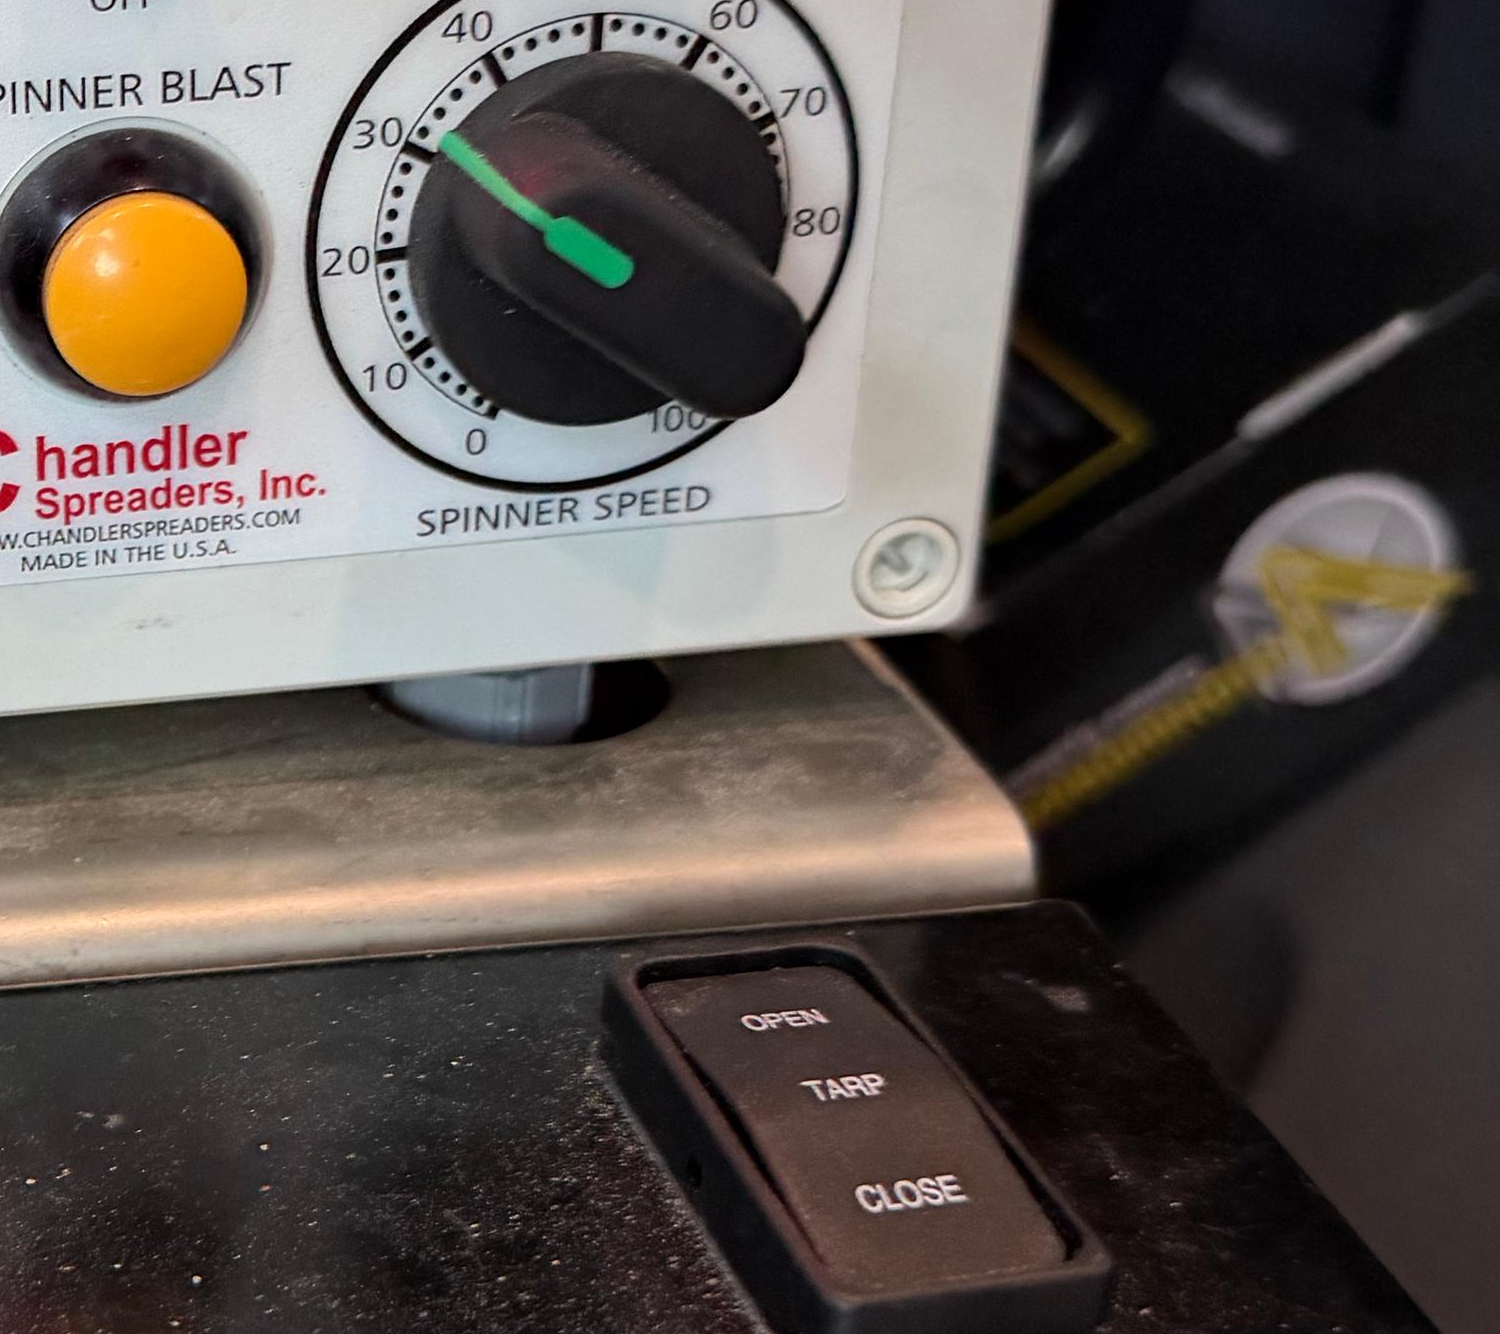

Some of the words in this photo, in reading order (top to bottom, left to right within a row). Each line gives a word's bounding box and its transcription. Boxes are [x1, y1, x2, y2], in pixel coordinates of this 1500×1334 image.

[441, 9, 494, 43] 40
[160, 61, 292, 103] BLAST
[780, 85, 828, 118] 70
[355, 115, 402, 150] 30
[791, 205, 842, 238] 80
[321, 244, 371, 278] 20
[362, 361, 408, 393] 10
[648, 404, 706, 434] 100
[465, 428, 488, 456] 0
[35, 475, 245, 526] Spreaders,
[260, 467, 327, 501] Inc.
[416, 496, 581, 538] SPINNER
[593, 484, 713, 524] SPEED
[21, 553, 88, 573] MADE
[94, 547, 117, 566] IN
[125, 544, 165, 564] THE
[172, 537, 237, 560] U.S.A.
[741, 1009, 830, 1032] OPEN
[800, 1073, 887, 1102] TARP
[855, 1174, 970, 1213] CLOSE
